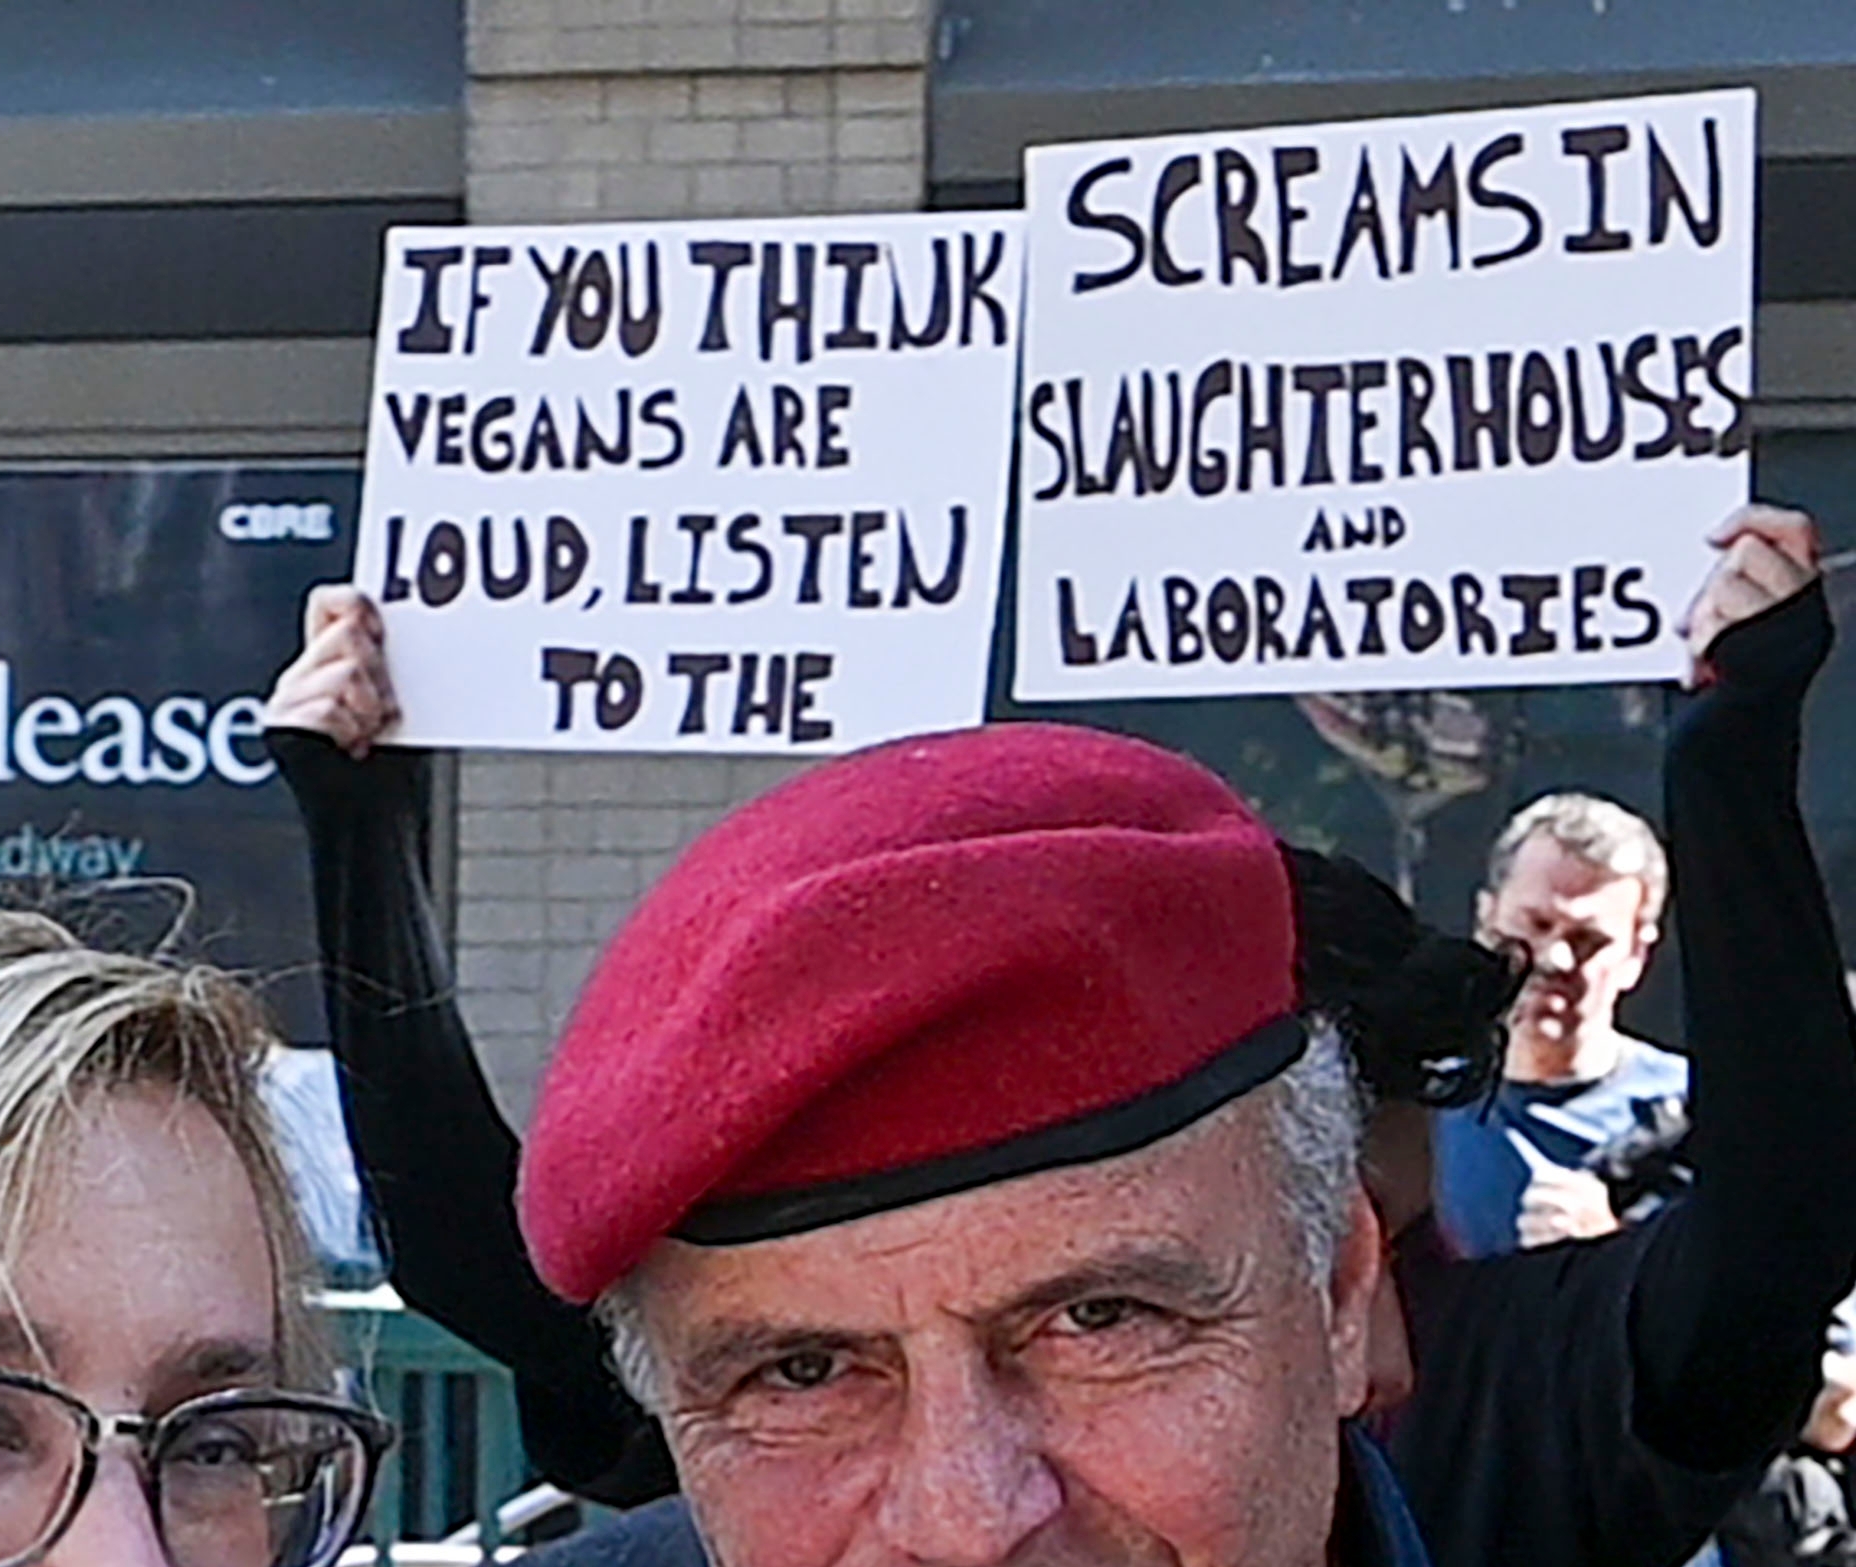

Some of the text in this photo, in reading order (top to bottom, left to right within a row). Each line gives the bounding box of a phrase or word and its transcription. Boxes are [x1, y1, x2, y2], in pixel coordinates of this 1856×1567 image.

[1065, 117, 1723, 296] SCREAMS IN
[396, 232, 1009, 365] IF YOU THINK
[384, 384, 853, 475] VEGANS ARE
[1028, 326, 1749, 502] SLAUGHTERHOUSES
[380, 505, 968, 614] LOUD, LISTEN
[1302, 505, 1407, 554] AND
[540, 646, 835, 745] TO THE
